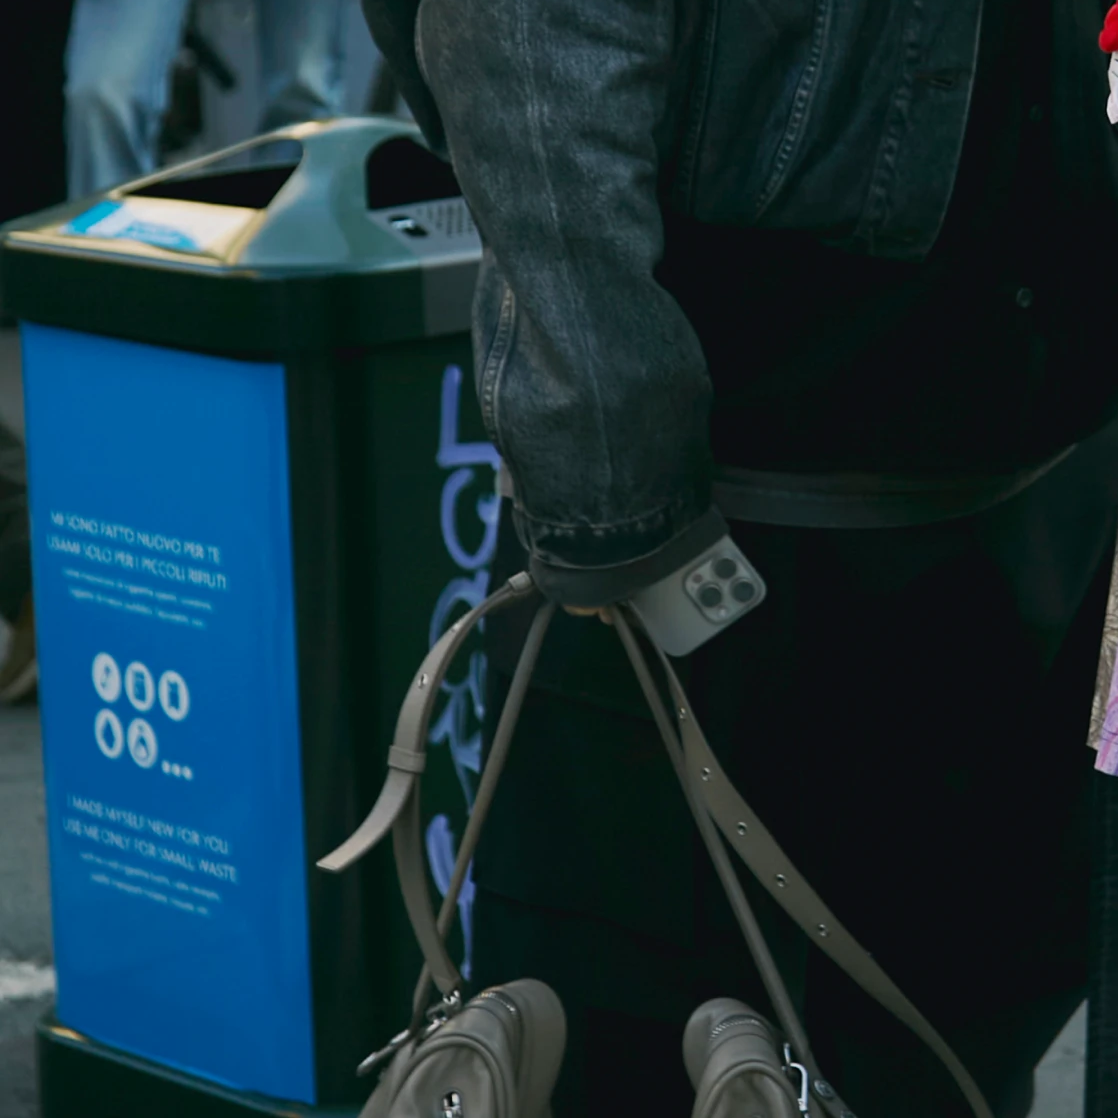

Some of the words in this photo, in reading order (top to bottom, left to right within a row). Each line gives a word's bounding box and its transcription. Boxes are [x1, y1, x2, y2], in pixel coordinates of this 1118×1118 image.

[67, 514, 99, 534] SONO
[100, 522, 135, 543] FATTO
[137, 530, 181, 553] NUOVO
[184, 542, 205, 559] PER
[208, 545, 221, 564] TE
[83, 543, 112, 562] SOLO
[114, 551, 134, 568] PER
[141, 557, 185, 581] PICCOLI
[134, 837, 156, 857] FOR
[158, 845, 194, 871] SMALL
[198, 858, 238, 883] WASTE
[177, 826, 200, 846] FOR
[203, 834, 229, 854] YOU
